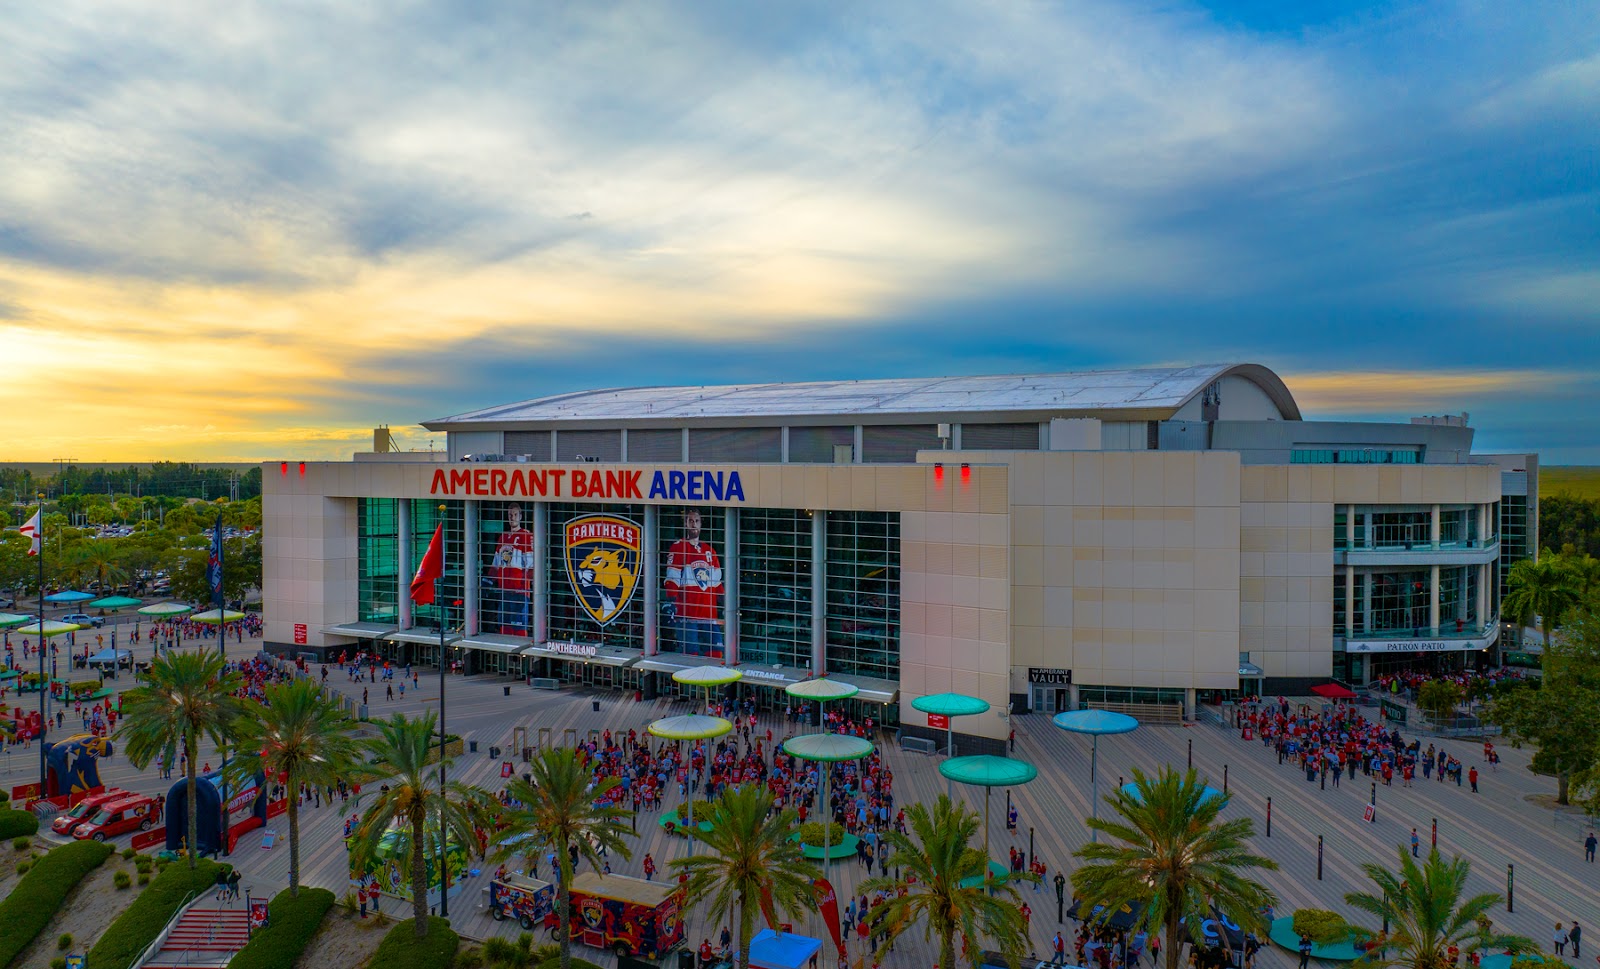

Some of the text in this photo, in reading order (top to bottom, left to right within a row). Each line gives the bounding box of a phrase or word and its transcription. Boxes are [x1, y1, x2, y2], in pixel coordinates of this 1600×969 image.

[430, 469, 745, 501] AMERANT BANK ARENA
[573, 523, 633, 543] PANTHERS
[547, 642, 596, 655] PANTHERLAND
[746, 670, 785, 680] ENTRANCE
[1032, 674, 1069, 683] VAULT
